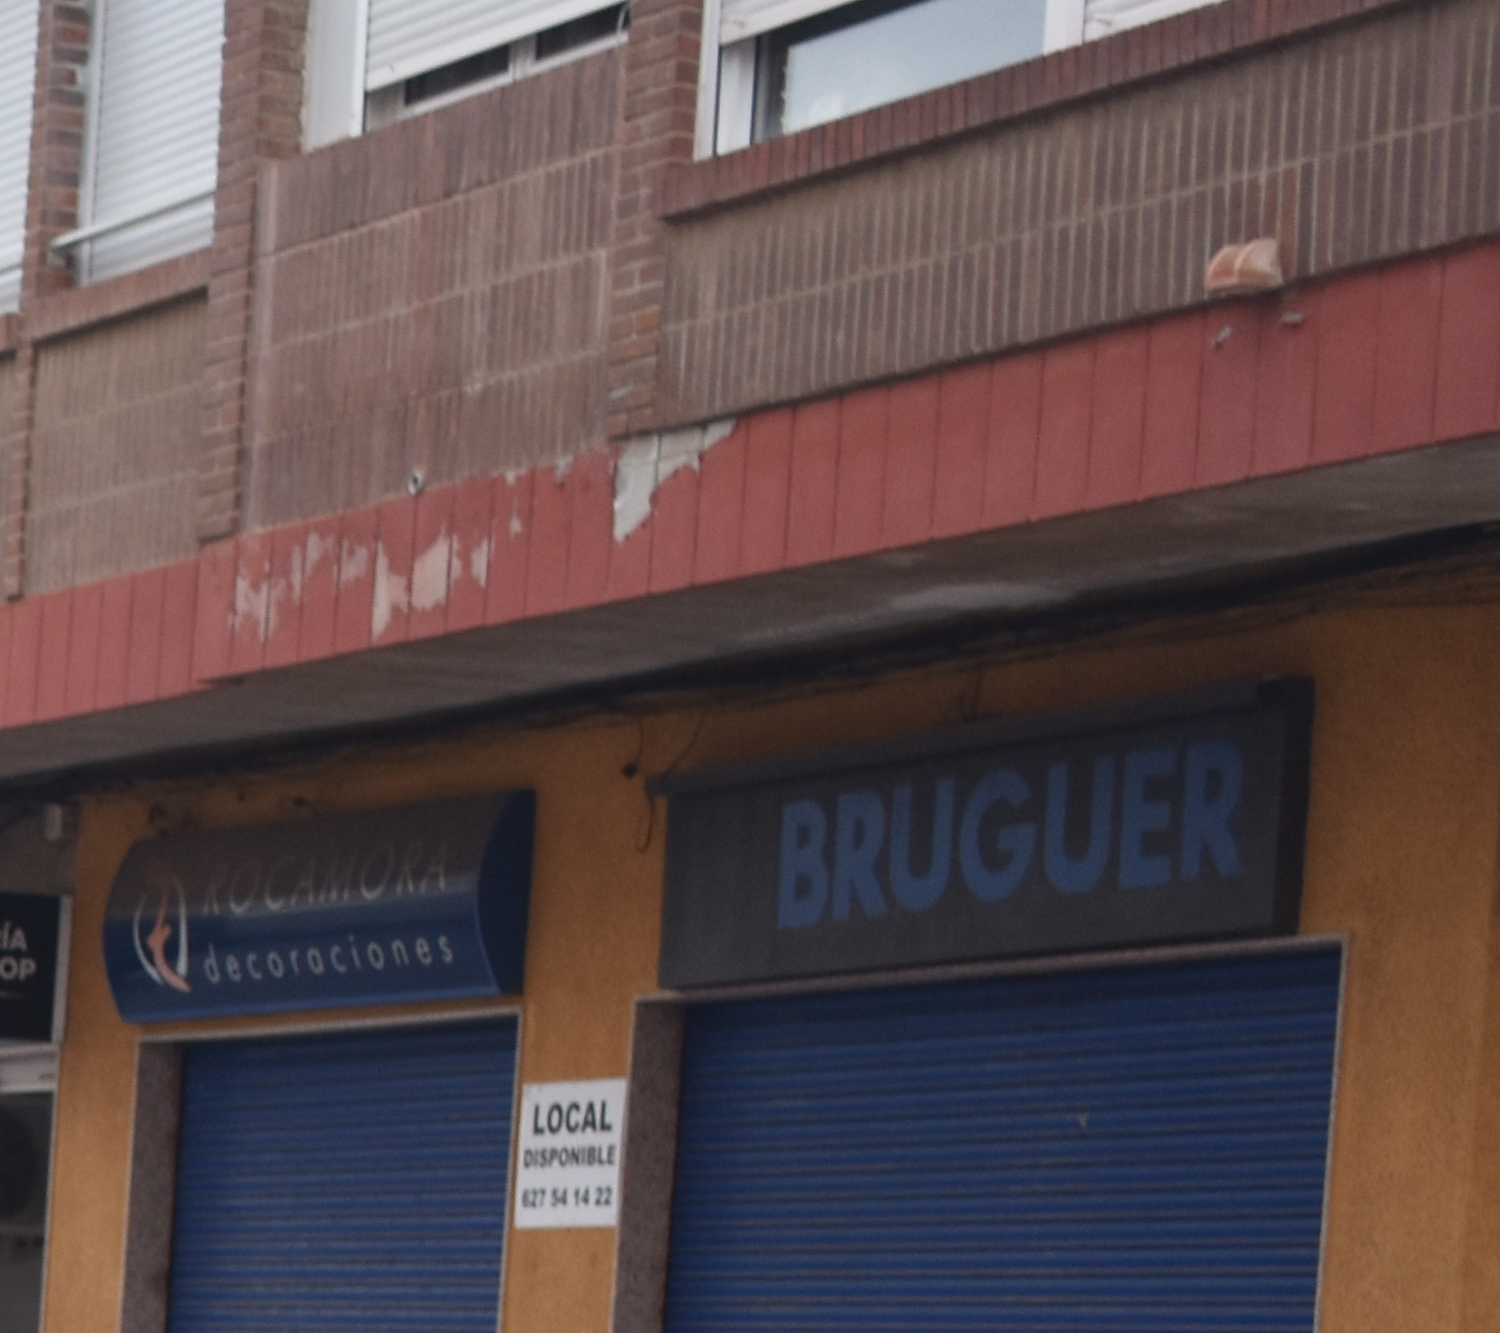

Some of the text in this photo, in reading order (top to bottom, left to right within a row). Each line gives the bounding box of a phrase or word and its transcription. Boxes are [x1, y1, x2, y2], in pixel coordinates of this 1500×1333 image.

[777, 740, 1244, 930] BRUGUER
[203, 840, 448, 916] ROCAMORA
[203, 934, 455, 984] decoraciones
[532, 1100, 613, 1135] LOCAL
[523, 1145, 615, 1168] DISPONIBLE
[551, 1186, 568, 1207] 54
[574, 1186, 590, 1206] 14
